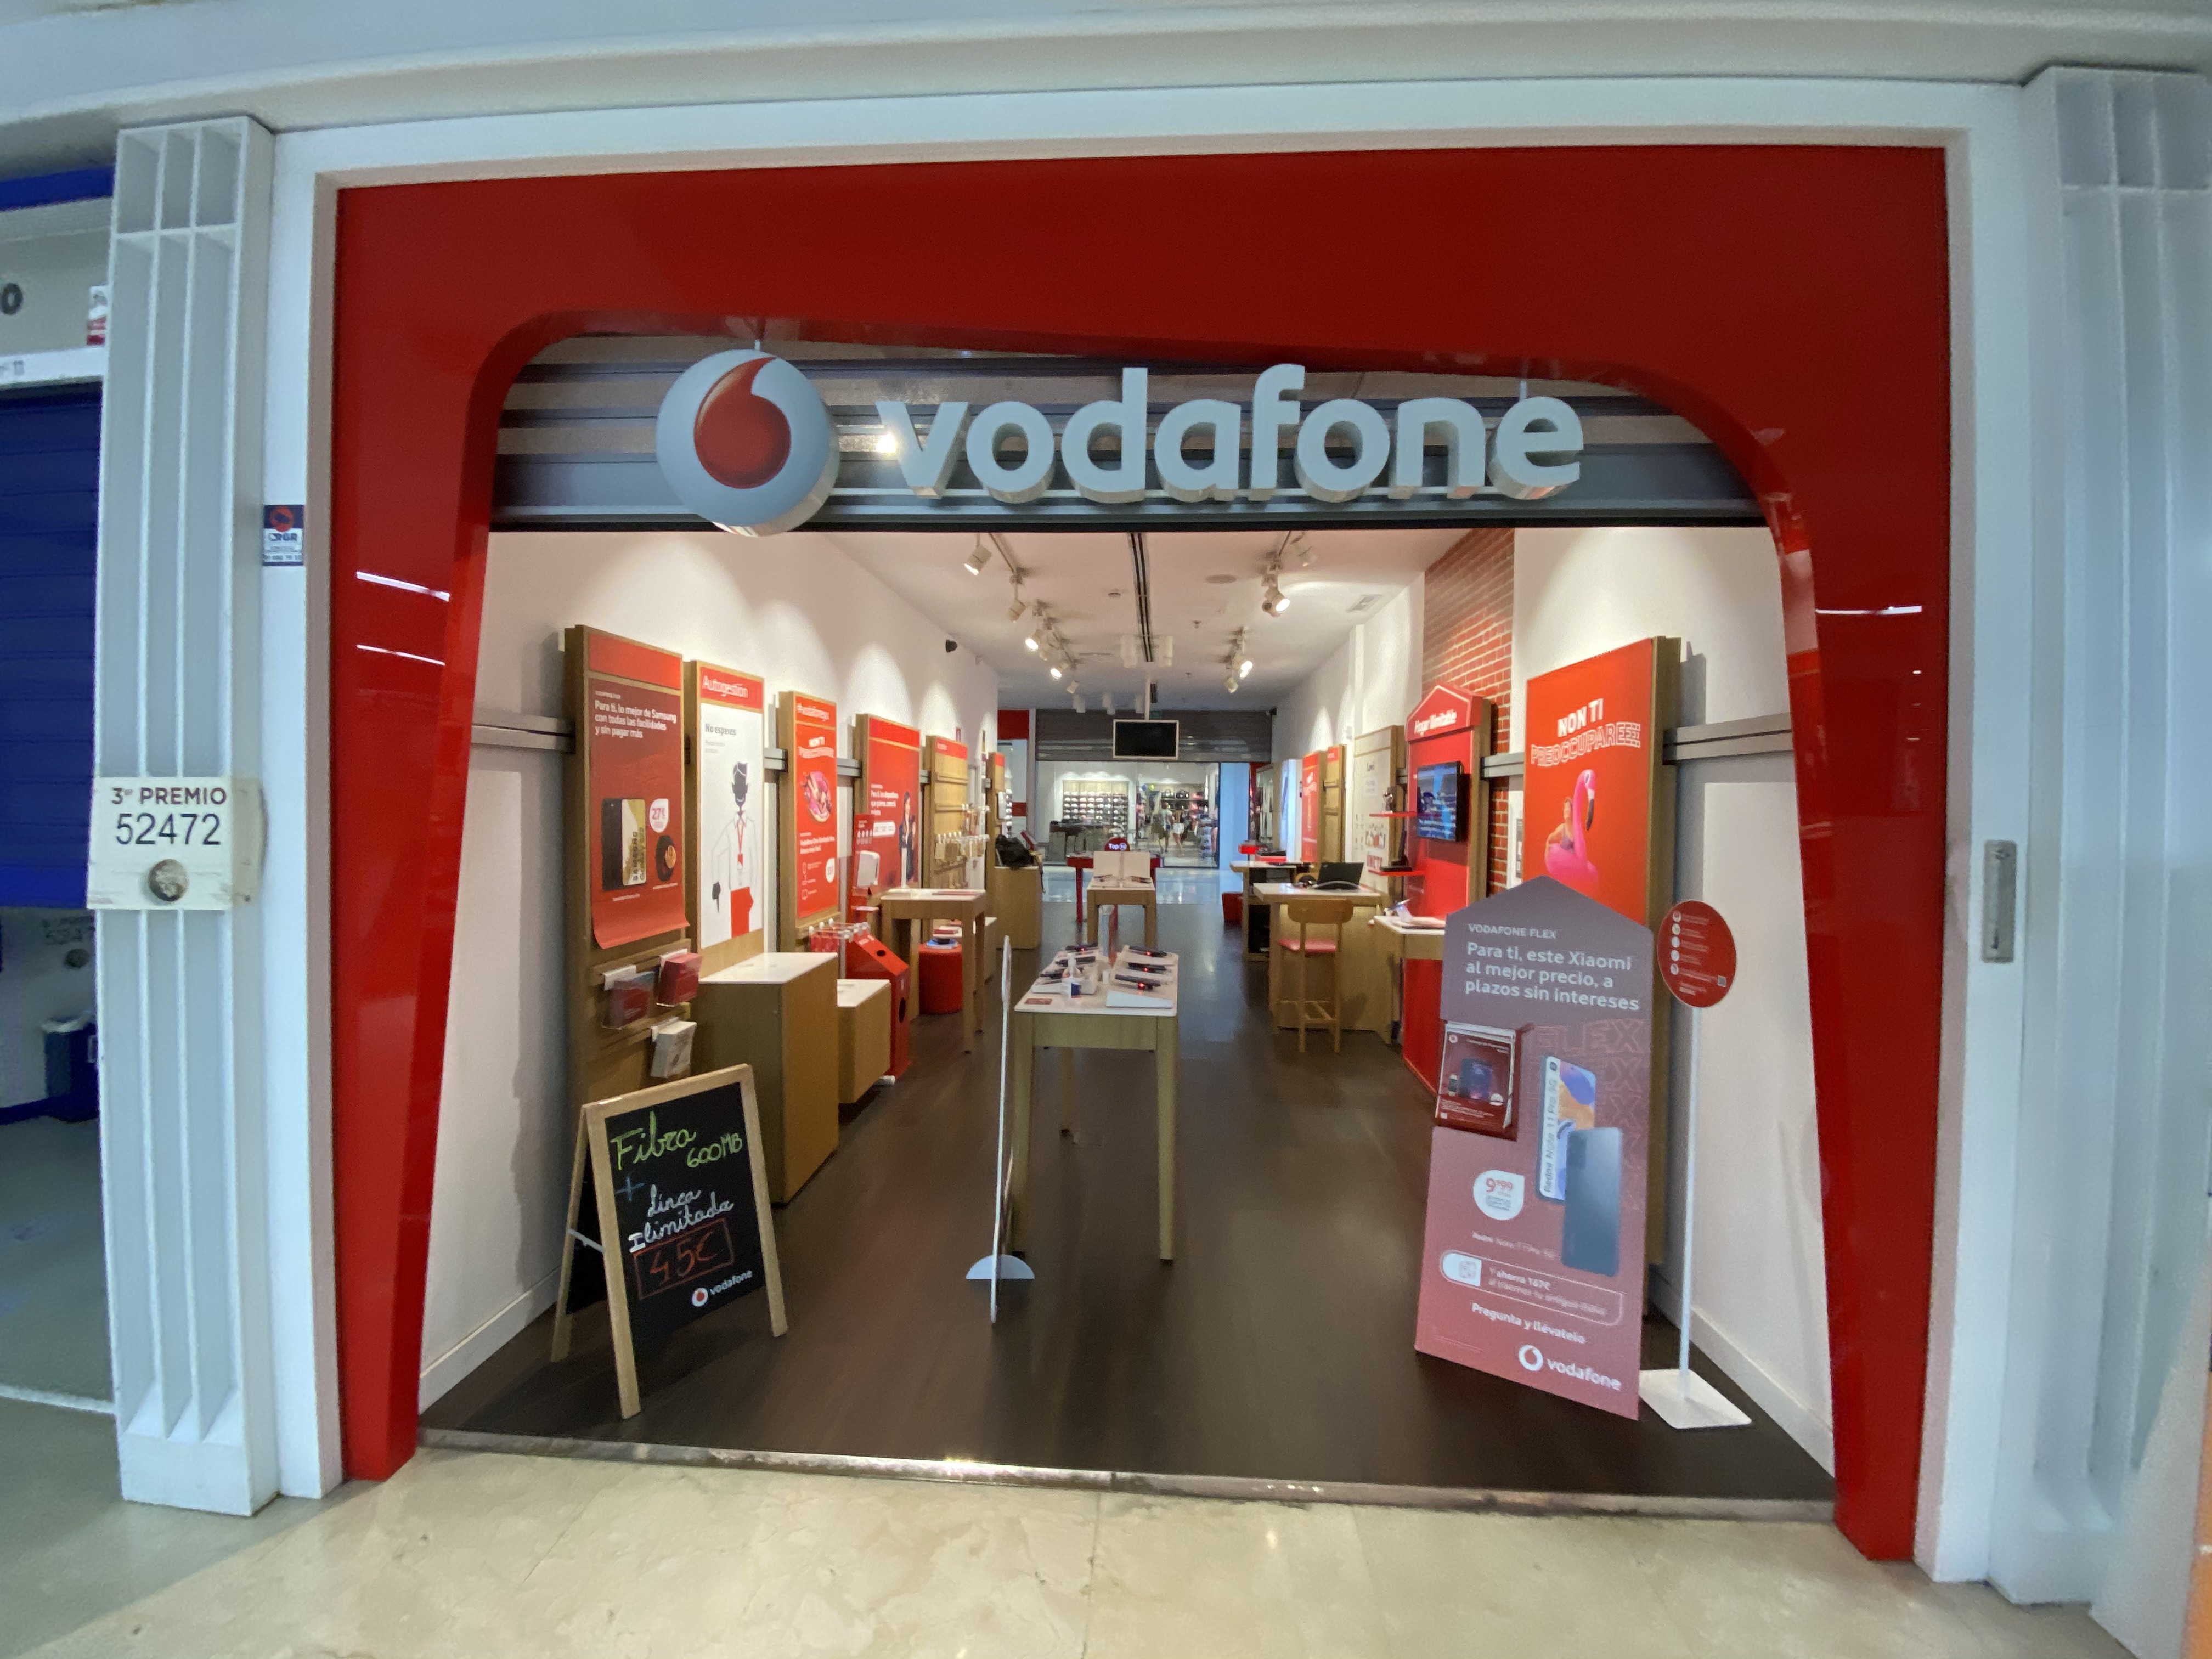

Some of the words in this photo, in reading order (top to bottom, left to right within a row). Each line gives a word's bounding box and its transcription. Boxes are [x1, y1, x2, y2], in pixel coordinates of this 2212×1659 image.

[876, 364, 1584, 504] vodafone
[595, 699, 610, 712] Para
[618, 703, 624, 713] lo
[625, 707, 642, 717] mejor
[644, 708, 651, 718] de
[651, 709, 676, 724] Samsung
[608, 715, 626, 725] todas
[627, 716, 636, 726] las
[1558, 706, 1587, 737] NON
[1588, 698, 1604, 723] TI
[612, 728, 629, 738] pagar
[706, 724, 713, 732] No
[714, 727, 736, 736] esperes
[140, 787, 227, 805] PREMIO
[116, 813, 221, 845] 52472
[1468, 923, 1527, 936] VODAFONE
[1530, 928, 1557, 939] FLEX
[1467, 941, 1503, 958] Para
[1506, 946, 1522, 961] ti,
[1527, 950, 1564, 964] este
[1568, 951, 1632, 970] Xiaomi
[1466, 961, 1481, 975] al
[1486, 964, 1535, 981] mejor
[1539, 970, 1599, 989] precio,
[1603, 976, 1613, 988] a
[1465, 979, 1520, 997] plazos
[1523, 986, 1549, 1001] sin
[1554, 988, 1640, 1011] intereses
[610, 1110, 697, 1170] Fibra
[687, 1133, 742, 1167] 600MB
[628, 1191, 734, 1253] Ilimitada
[710, 1270, 753, 1295] vodafone
[1472, 1303, 1521, 1325] Pregunta
[1523, 1319, 1532, 1330] y
[1547, 1359, 1622, 1391] vodafone
